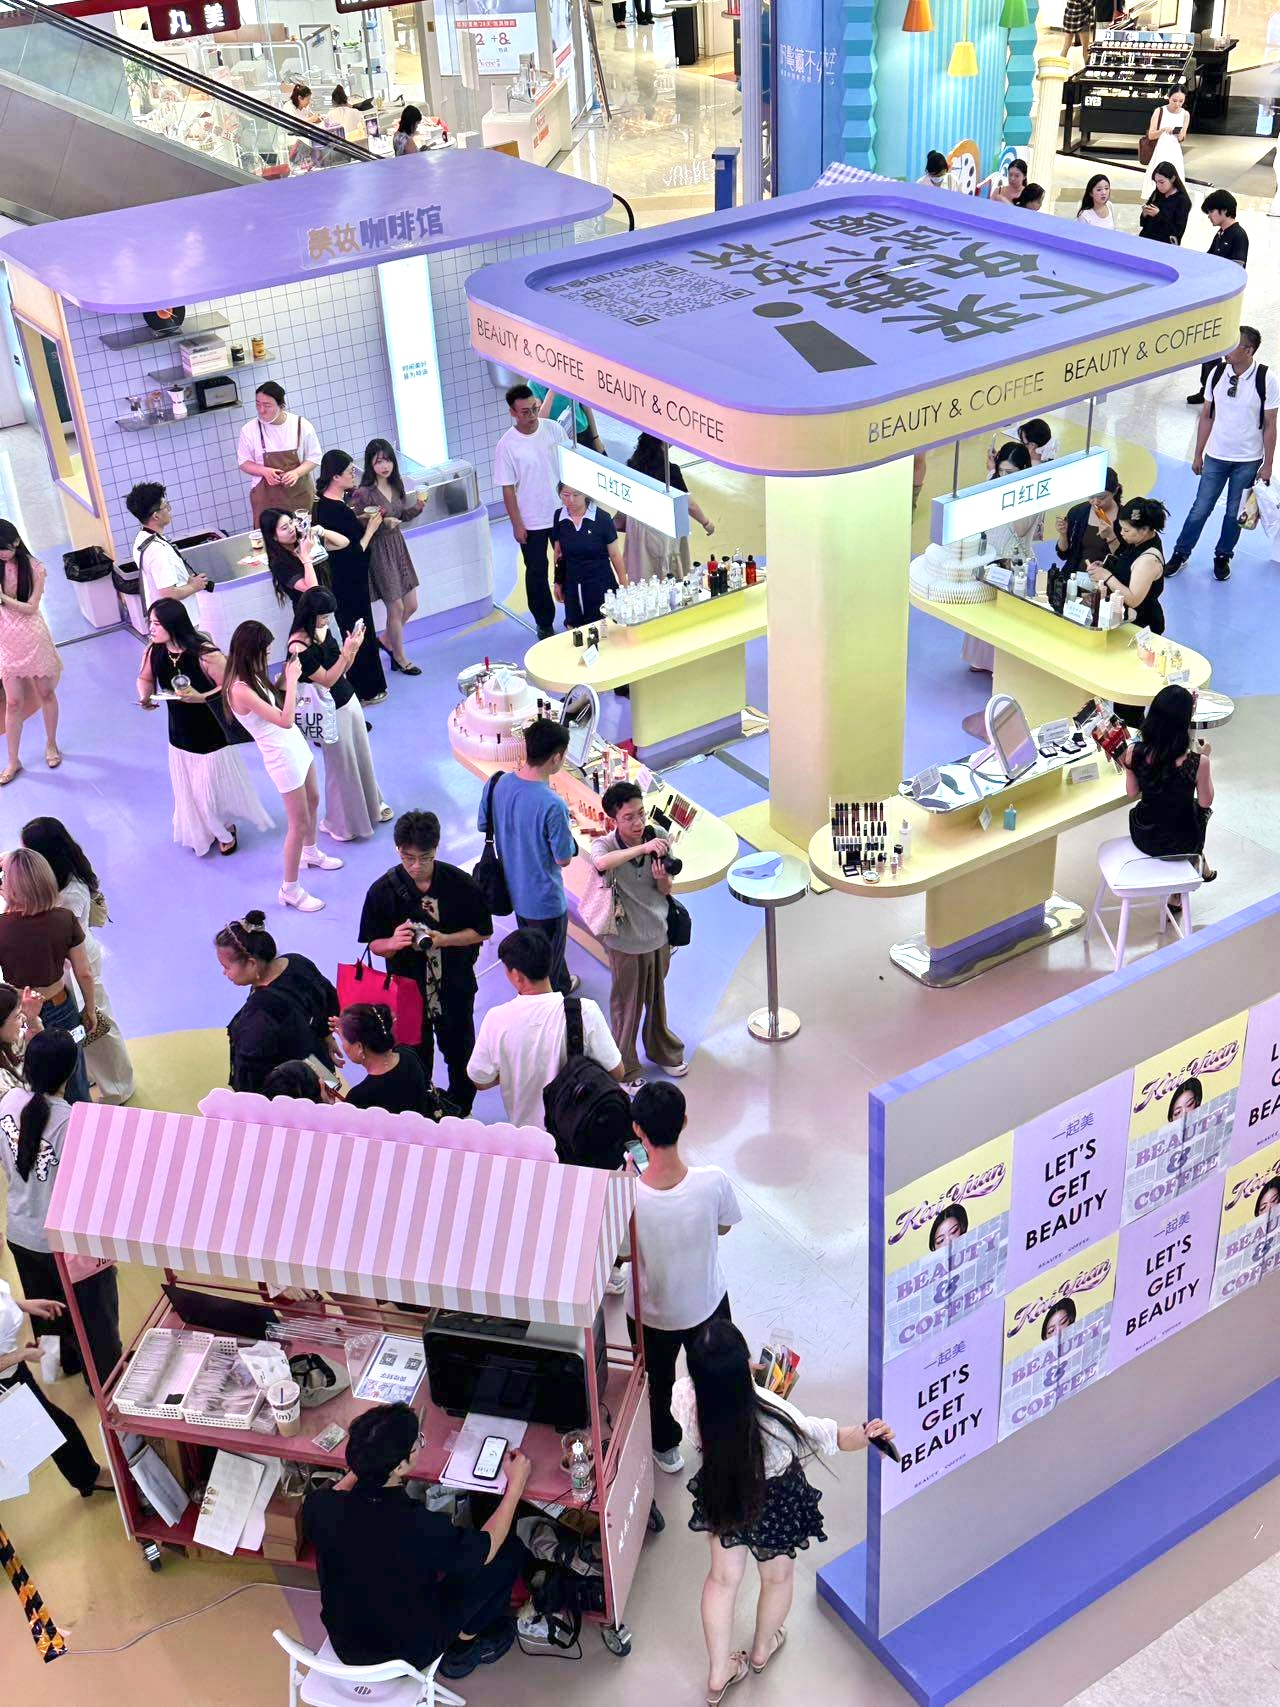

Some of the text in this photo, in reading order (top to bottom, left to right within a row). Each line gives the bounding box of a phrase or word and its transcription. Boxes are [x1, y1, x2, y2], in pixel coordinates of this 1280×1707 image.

[308, 204, 443, 259] 美妆咖啡馆
[688, 211, 908, 270] 喝一杯
[728, 226, 972, 286] 试个妆
[787, 241, 1040, 313] 免费
[880, 275, 1153, 344] 下来
[477, 317, 585, 381] BEAUTY & COFFEE
[1064, 317, 1223, 382] BEAUTY & COFFEE
[598, 369, 724, 443] BEAUTY & COFFEE
[869, 371, 1044, 443] BEAUTY & COFFEE
[597, 472, 632, 503] 口红区
[1002, 478, 1052, 510] 口红区
[301, 726, 324, 739] VER
[306, 712, 323, 726] UP
[1050, 1112, 1093, 1139] 一起美
[1135, 1106, 1230, 1168] BEAUTY
[1045, 1139, 1096, 1182] LET'S
[1135, 1152, 1219, 1210] COFFEE
[1167, 1146, 1191, 1173] &
[1048, 1170, 1090, 1207] GET
[1026, 1188, 1107, 1250] BEAUTY
[1153, 1211, 1190, 1237] 一起美
[896, 1231, 1000, 1303] BEAUTY
[1146, 1235, 1191, 1275] LET'S
[1147, 1262, 1185, 1297] GET
[899, 1279, 993, 1344] COFFEE
[934, 1274, 960, 1303] &
[1126, 1278, 1199, 1336] BEAUTY
[923, 1341, 967, 1369] 一起美
[1011, 1321, 1102, 1387] BEAUTY
[1043, 1360, 1068, 1387] &
[918, 1364, 969, 1409] LET'S
[922, 1393, 964, 1431] GET
[1012, 1362, 1097, 1424] COFFEE
[901, 1408, 982, 1473] BEAUTY
